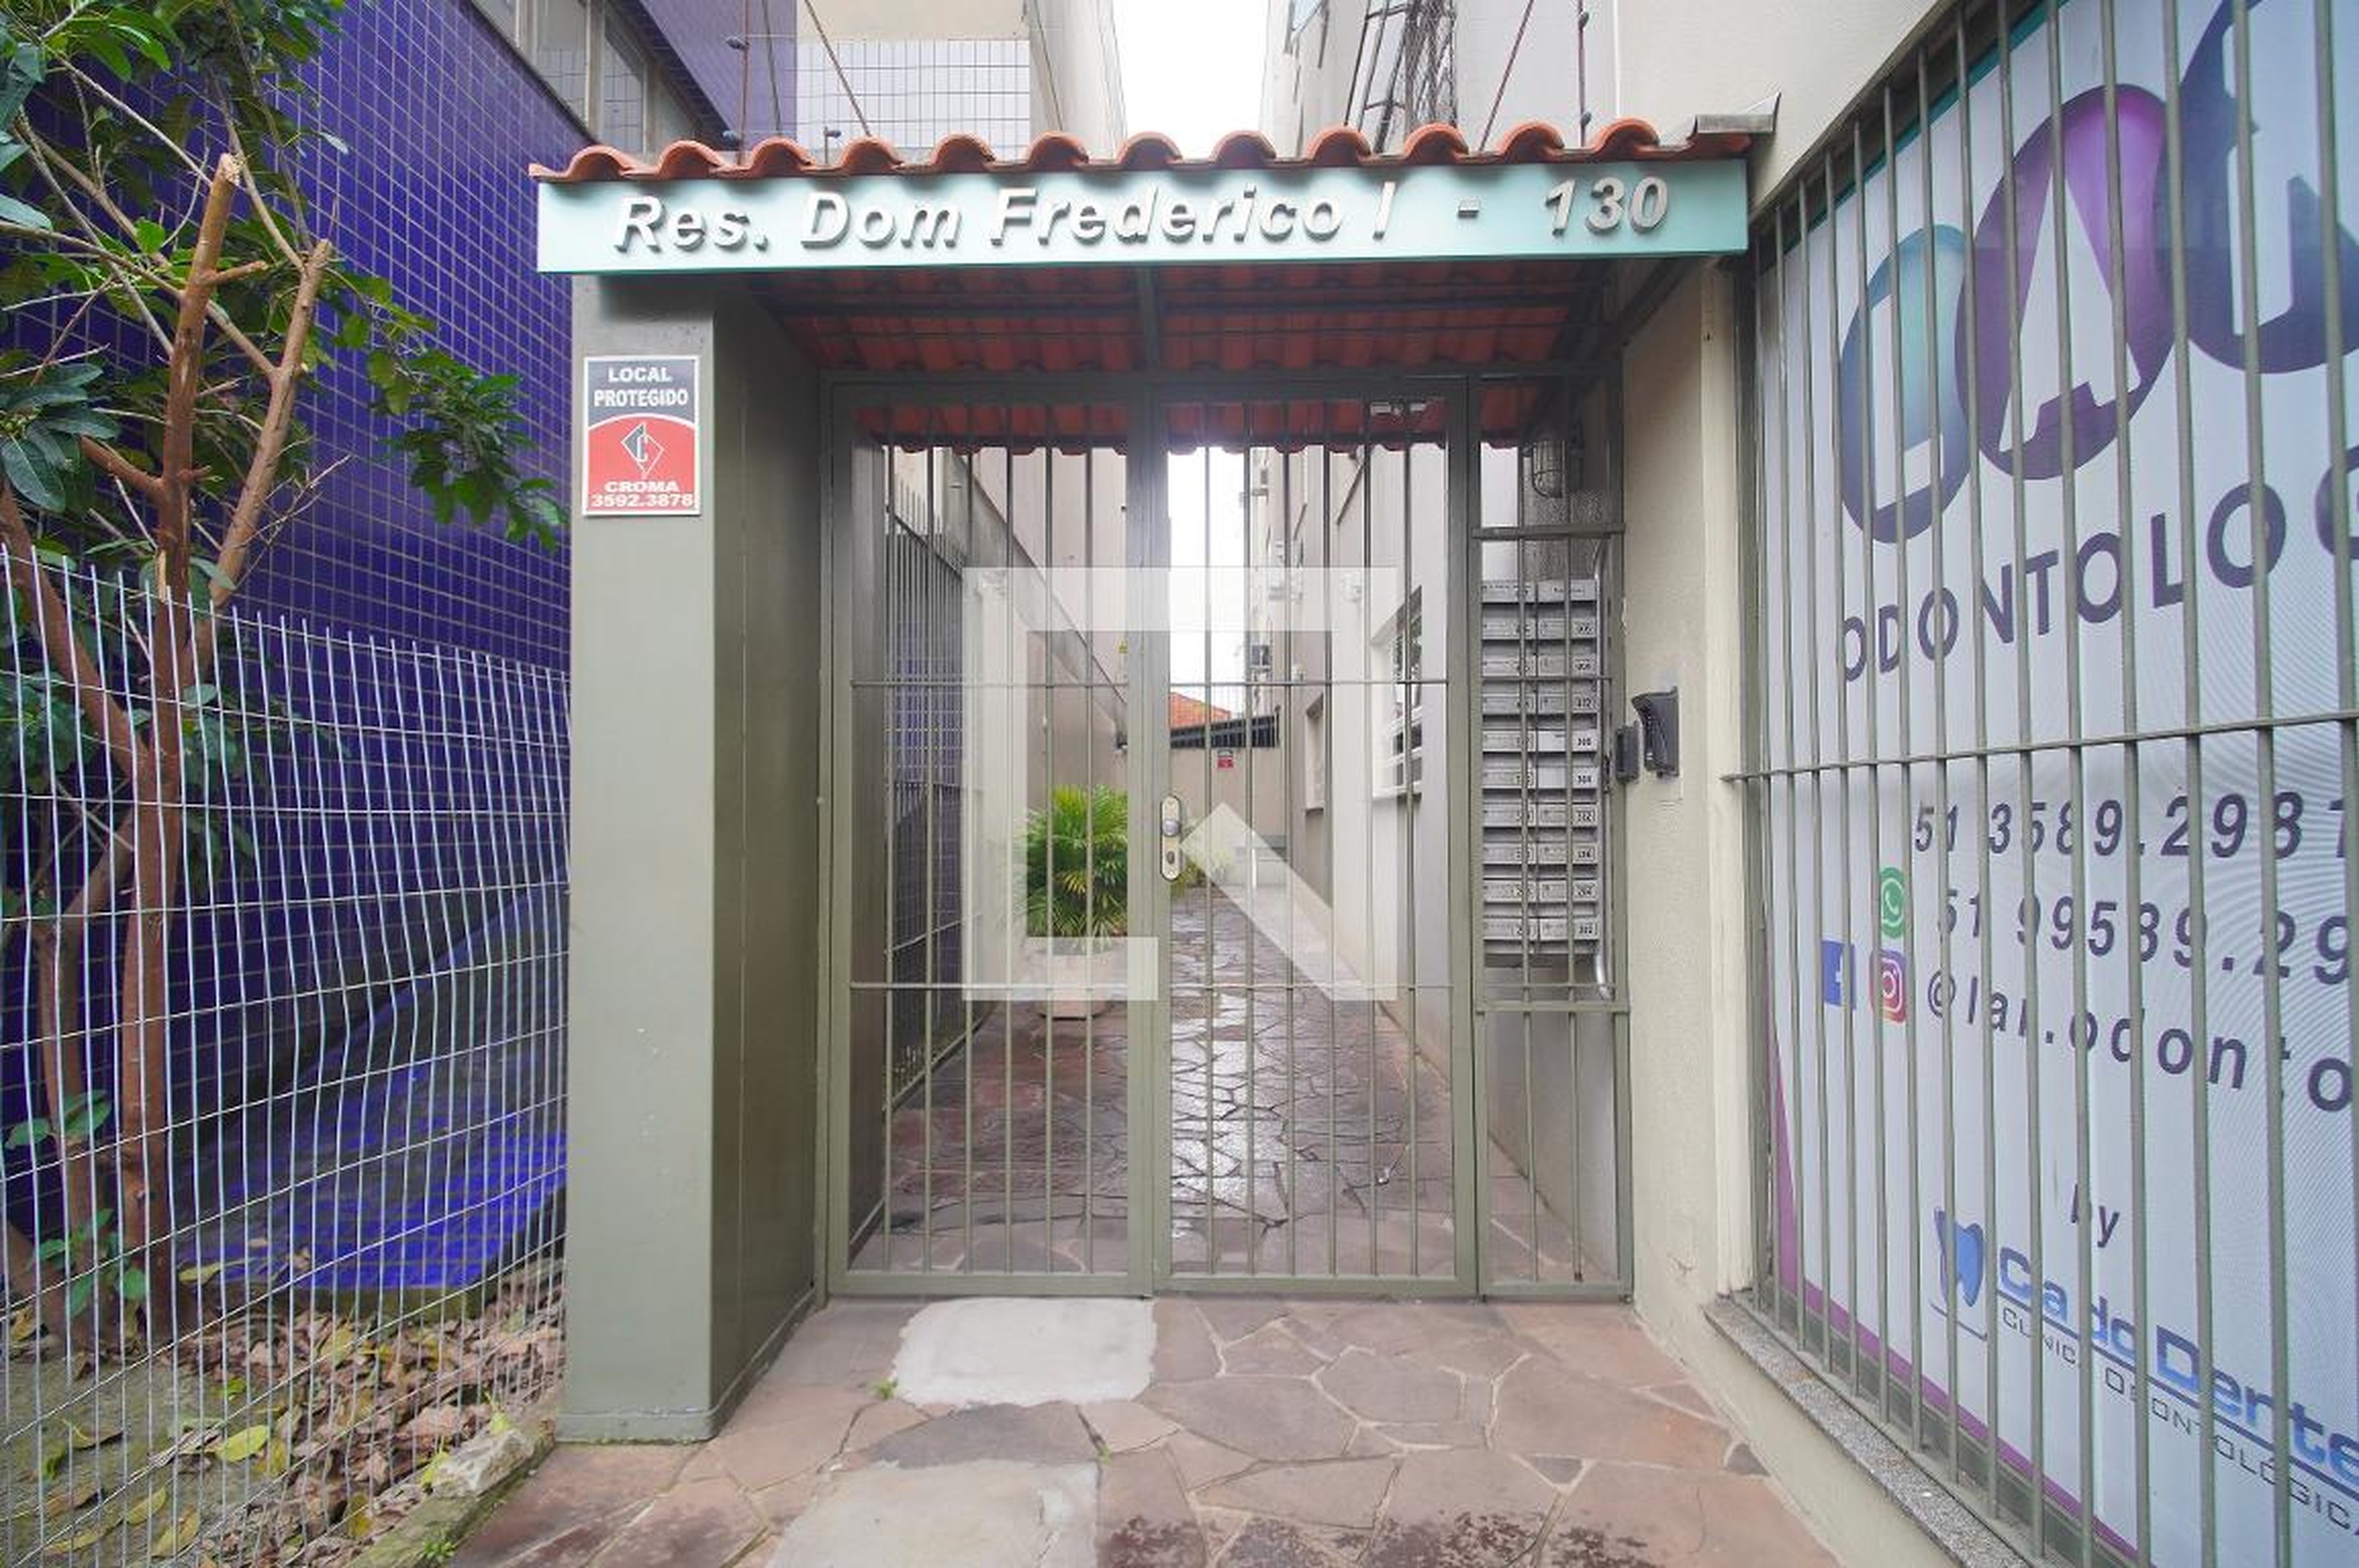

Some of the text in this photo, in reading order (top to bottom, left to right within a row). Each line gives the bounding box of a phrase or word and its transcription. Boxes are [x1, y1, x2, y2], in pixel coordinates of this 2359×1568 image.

[616, 176, 1670, 252] Res. Dom Frederico I - 130
[608, 367, 673, 383] LOCAL
[593, 388, 689, 407] PROTEGIDO
[603, 480, 680, 493] CROMA
[591, 494, 694, 507] 3592.3878
[1915, 800, 1958, 852] 51
